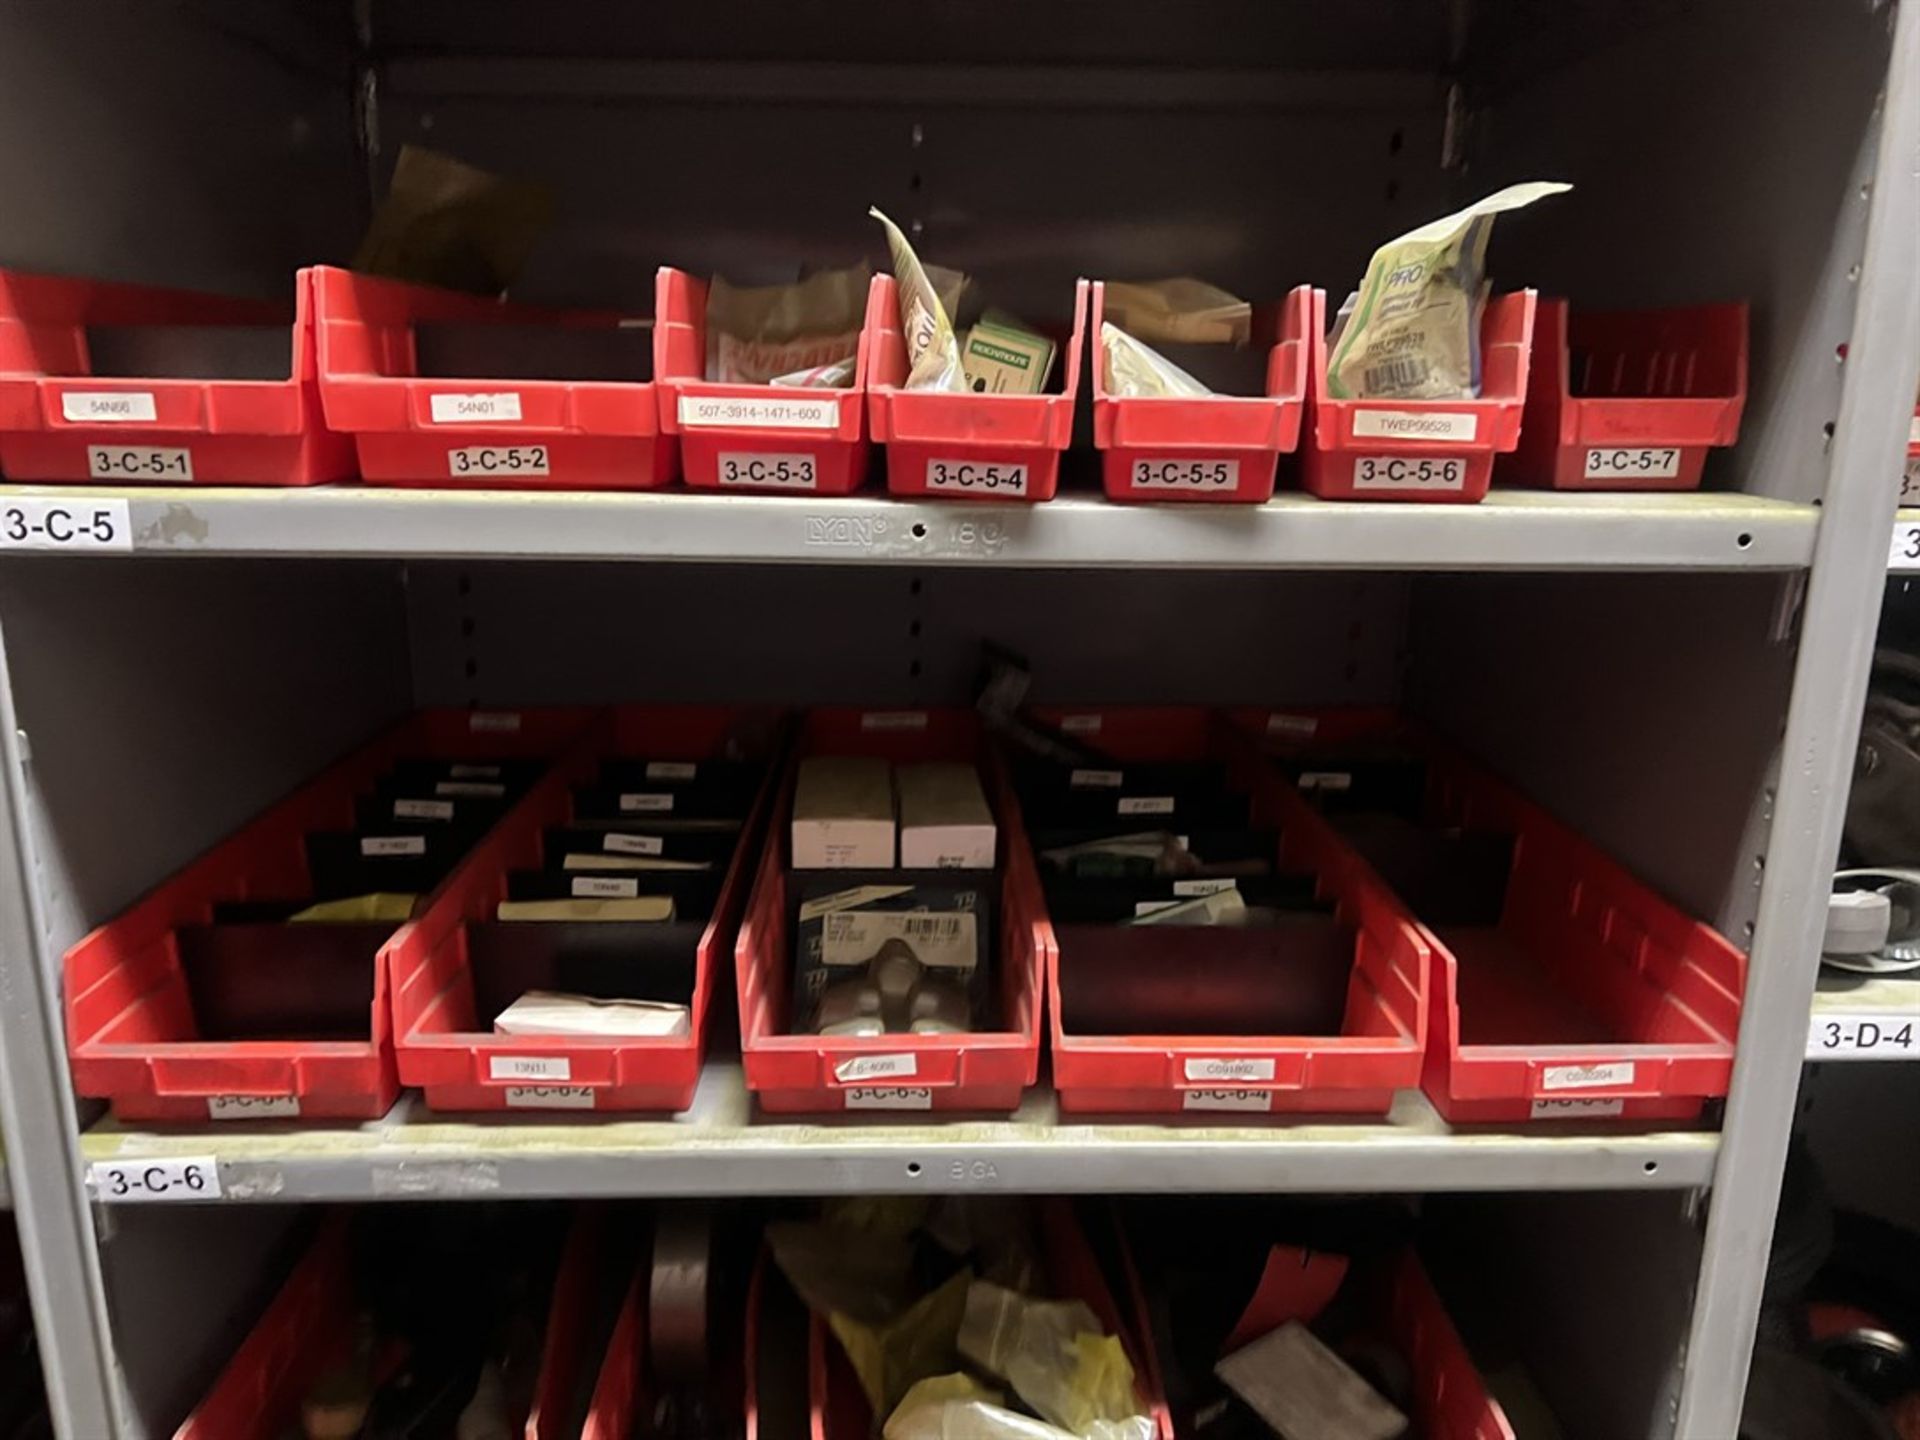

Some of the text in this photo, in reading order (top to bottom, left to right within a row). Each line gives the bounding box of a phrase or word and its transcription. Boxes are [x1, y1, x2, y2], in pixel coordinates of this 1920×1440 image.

[698, 405, 822, 420] 507-3914-1471-600
[96, 450, 187, 474] 3-C-5-1
[456, 447, 547, 471] 3-C-5-2
[725, 460, 814, 482] 3-C-5-3
[1361, 459, 1459, 482] 3-C-5-6
[1588, 450, 1676, 471] 3-C-5-7
[934, 463, 1024, 490] 3-C-5-4
[1136, 463, 1228, 484] 3-C-5-5
[6, 508, 114, 542] 3-C-5
[1822, 1022, 1914, 1050] 3-D-4
[108, 1165, 204, 1195] 3-C-6
